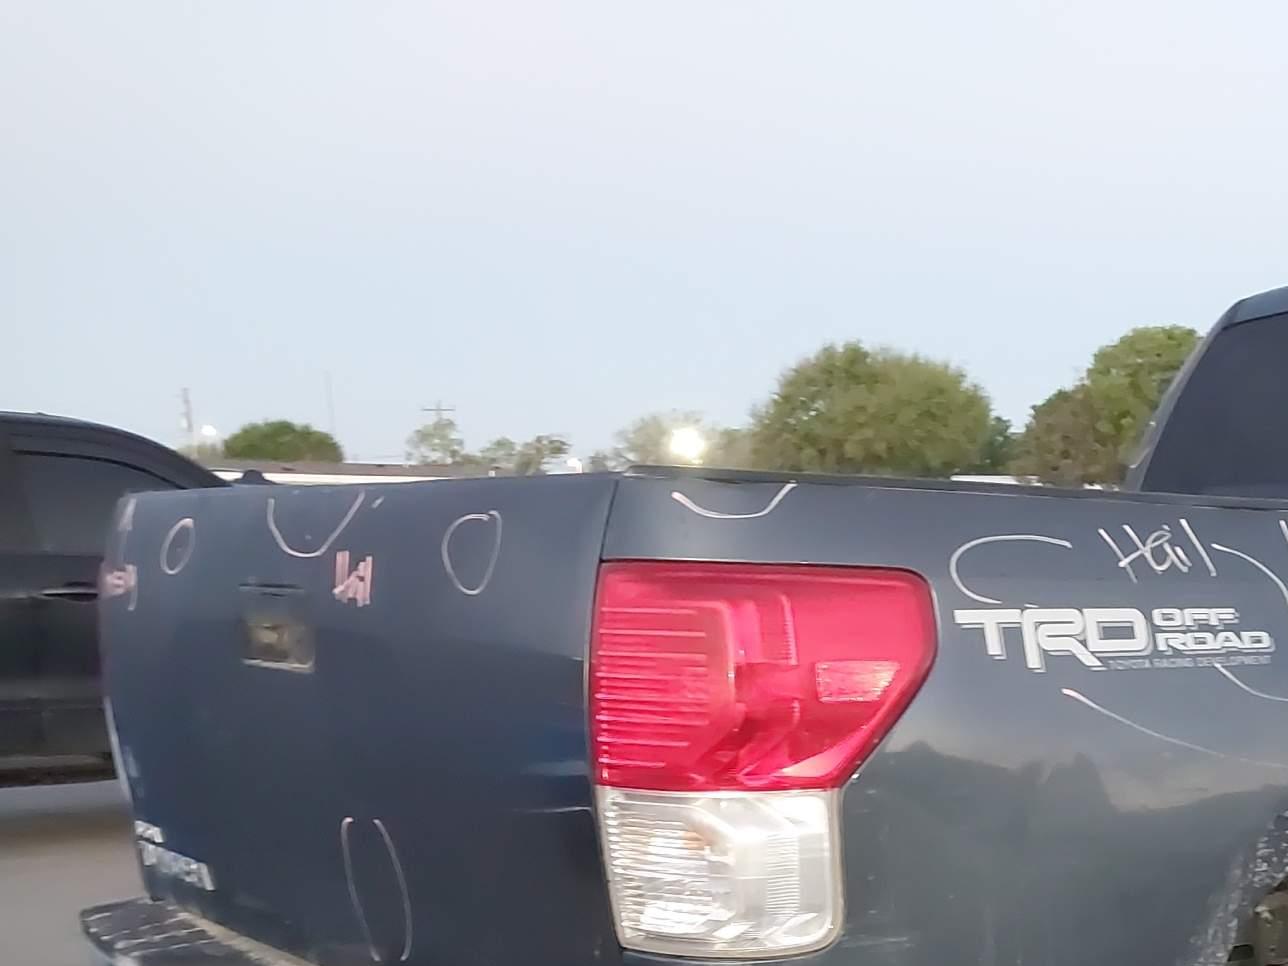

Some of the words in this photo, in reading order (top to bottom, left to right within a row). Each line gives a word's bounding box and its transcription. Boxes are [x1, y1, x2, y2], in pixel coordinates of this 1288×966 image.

[1098, 518, 1217, 583] Hail
[953, 608, 1152, 672] TRD
[1151, 607, 1240, 630] OFF
[1154, 631, 1276, 655] ROAD
